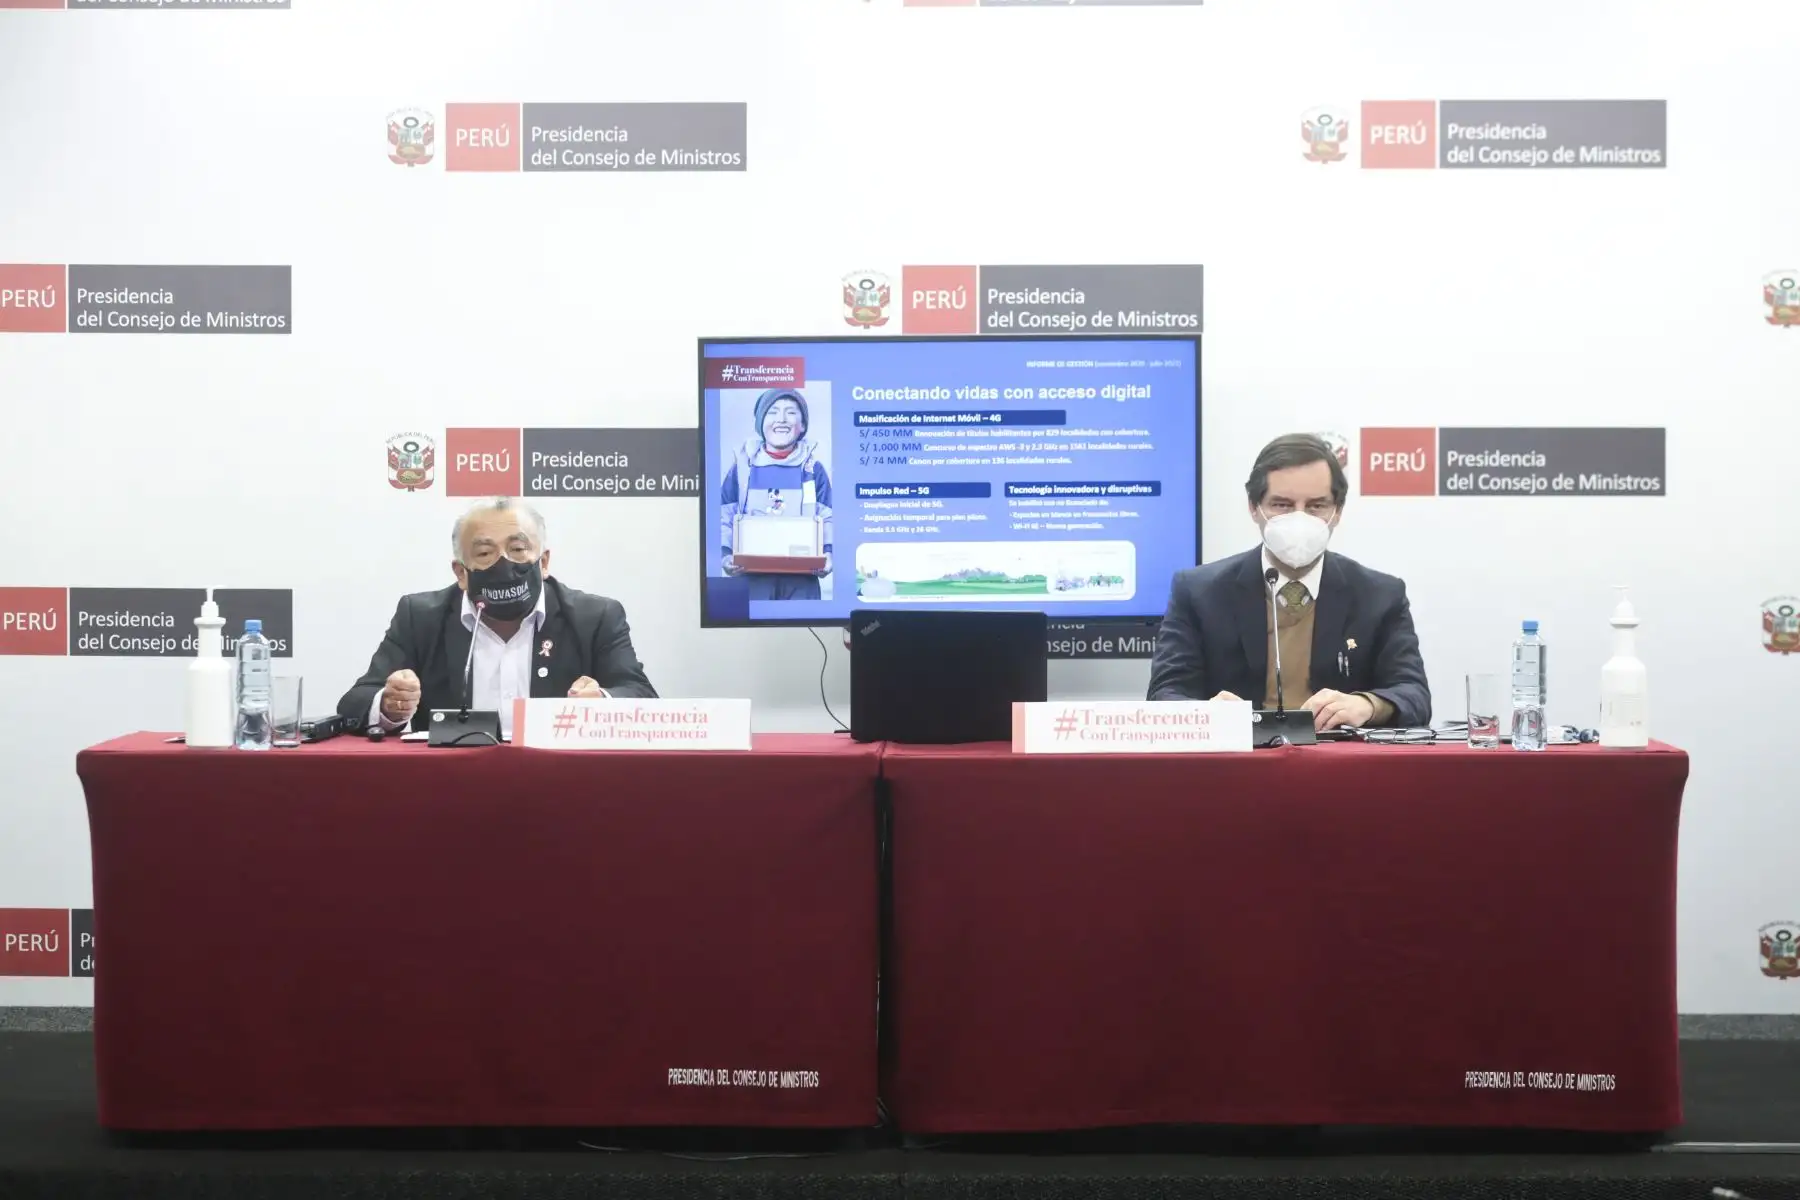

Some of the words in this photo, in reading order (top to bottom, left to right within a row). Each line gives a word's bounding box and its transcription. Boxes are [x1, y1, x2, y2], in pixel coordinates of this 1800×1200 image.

[457, 124, 509, 147] PERÚ
[532, 126, 627, 142] Presidencia
[1371, 120, 1426, 144] PERÚ
[1448, 123, 1546, 139] Presidencia
[532, 149, 556, 165] del
[562, 149, 629, 168] Consejo
[635, 149, 656, 164] de
[662, 149, 740, 164] Ministros
[1448, 146, 1474, 162] del
[1479, 146, 1549, 166] Consejo
[1553, 146, 1574, 162] de
[1580, 146, 1660, 162] Ministros
[1, 285, 55, 307] PERÚ
[78, 288, 173, 304] Presidencia
[913, 286, 966, 309] PERÚ
[988, 288, 1085, 304] Presidencia
[77, 310, 102, 326] del
[108, 312, 175, 330] Consejo
[181, 311, 201, 327] de
[207, 312, 285, 327] Ministros
[988, 311, 1013, 327] del
[1019, 312, 1087, 331] Consejo
[1092, 311, 1112, 327] de
[1118, 311, 1197, 327] Ministros
[852, 386, 950, 400] Conectando
[955, 386, 998, 399] vidas
[1003, 388, 1033, 399] con
[1038, 388, 1096, 399] acceso
[1101, 385, 1151, 401] digital
[859, 414, 909, 423] Masificación
[911, 414, 921, 422] de
[923, 415, 956, 423] Internet
[958, 413, 981, 422] Móvil
[990, 414, 1001, 422] 4G
[859, 429, 870, 438] S/
[872, 429, 890, 437] 450
[859, 443, 870, 452] S/
[902, 443, 922, 451] MM
[457, 449, 509, 472] PERÚ
[533, 451, 628, 467] Presidencia
[859, 457, 870, 466] S/
[873, 457, 884, 465] 74
[1371, 448, 1425, 471] PERÚ
[1448, 450, 1545, 466] Presidencia
[532, 474, 557, 490] del
[563, 475, 630, 493] Consejo
[635, 474, 656, 490] de
[860, 487, 892, 496] Impulso
[894, 487, 909, 495] Red
[918, 487, 929, 495] 5G
[1008, 485, 1052, 495] Tecnología
[1054, 485, 1099, 494] innovadora
[1101, 487, 1107, 495] y
[1447, 473, 1473, 489] del
[1478, 474, 1547, 493] Consejo
[1552, 474, 1574, 490] de
[1579, 474, 1660, 490] Ministros
[4, 608, 56, 630] PERÚ
[79, 611, 174, 627] Presidencia
[79, 634, 103, 649] del
[109, 635, 176, 653] Consejo
[182, 634, 199, 650] de
[1092, 636, 1112, 652] de
[553, 705, 708, 739] #Transferencia
[1054, 708, 1210, 740] #Transferencia
[579, 726, 708, 743] ConTransparencia
[1080, 727, 1210, 744] ConTransparencia
[6, 930, 58, 951] PERÚ
[669, 1068, 714, 1085] PRESIDENCIA
[717, 1069, 730, 1085] DEL
[733, 1070, 766, 1087] CONSEJO
[769, 1071, 778, 1087] DE
[781, 1071, 818, 1088] MINISTROS
[1465, 1072, 1510, 1088] PRESIDENCIA
[1513, 1072, 1525, 1087] DEL
[1529, 1072, 1563, 1088] CONSEJO
[1565, 1073, 1575, 1089] DE
[1577, 1074, 1615, 1090] MINISTROS
